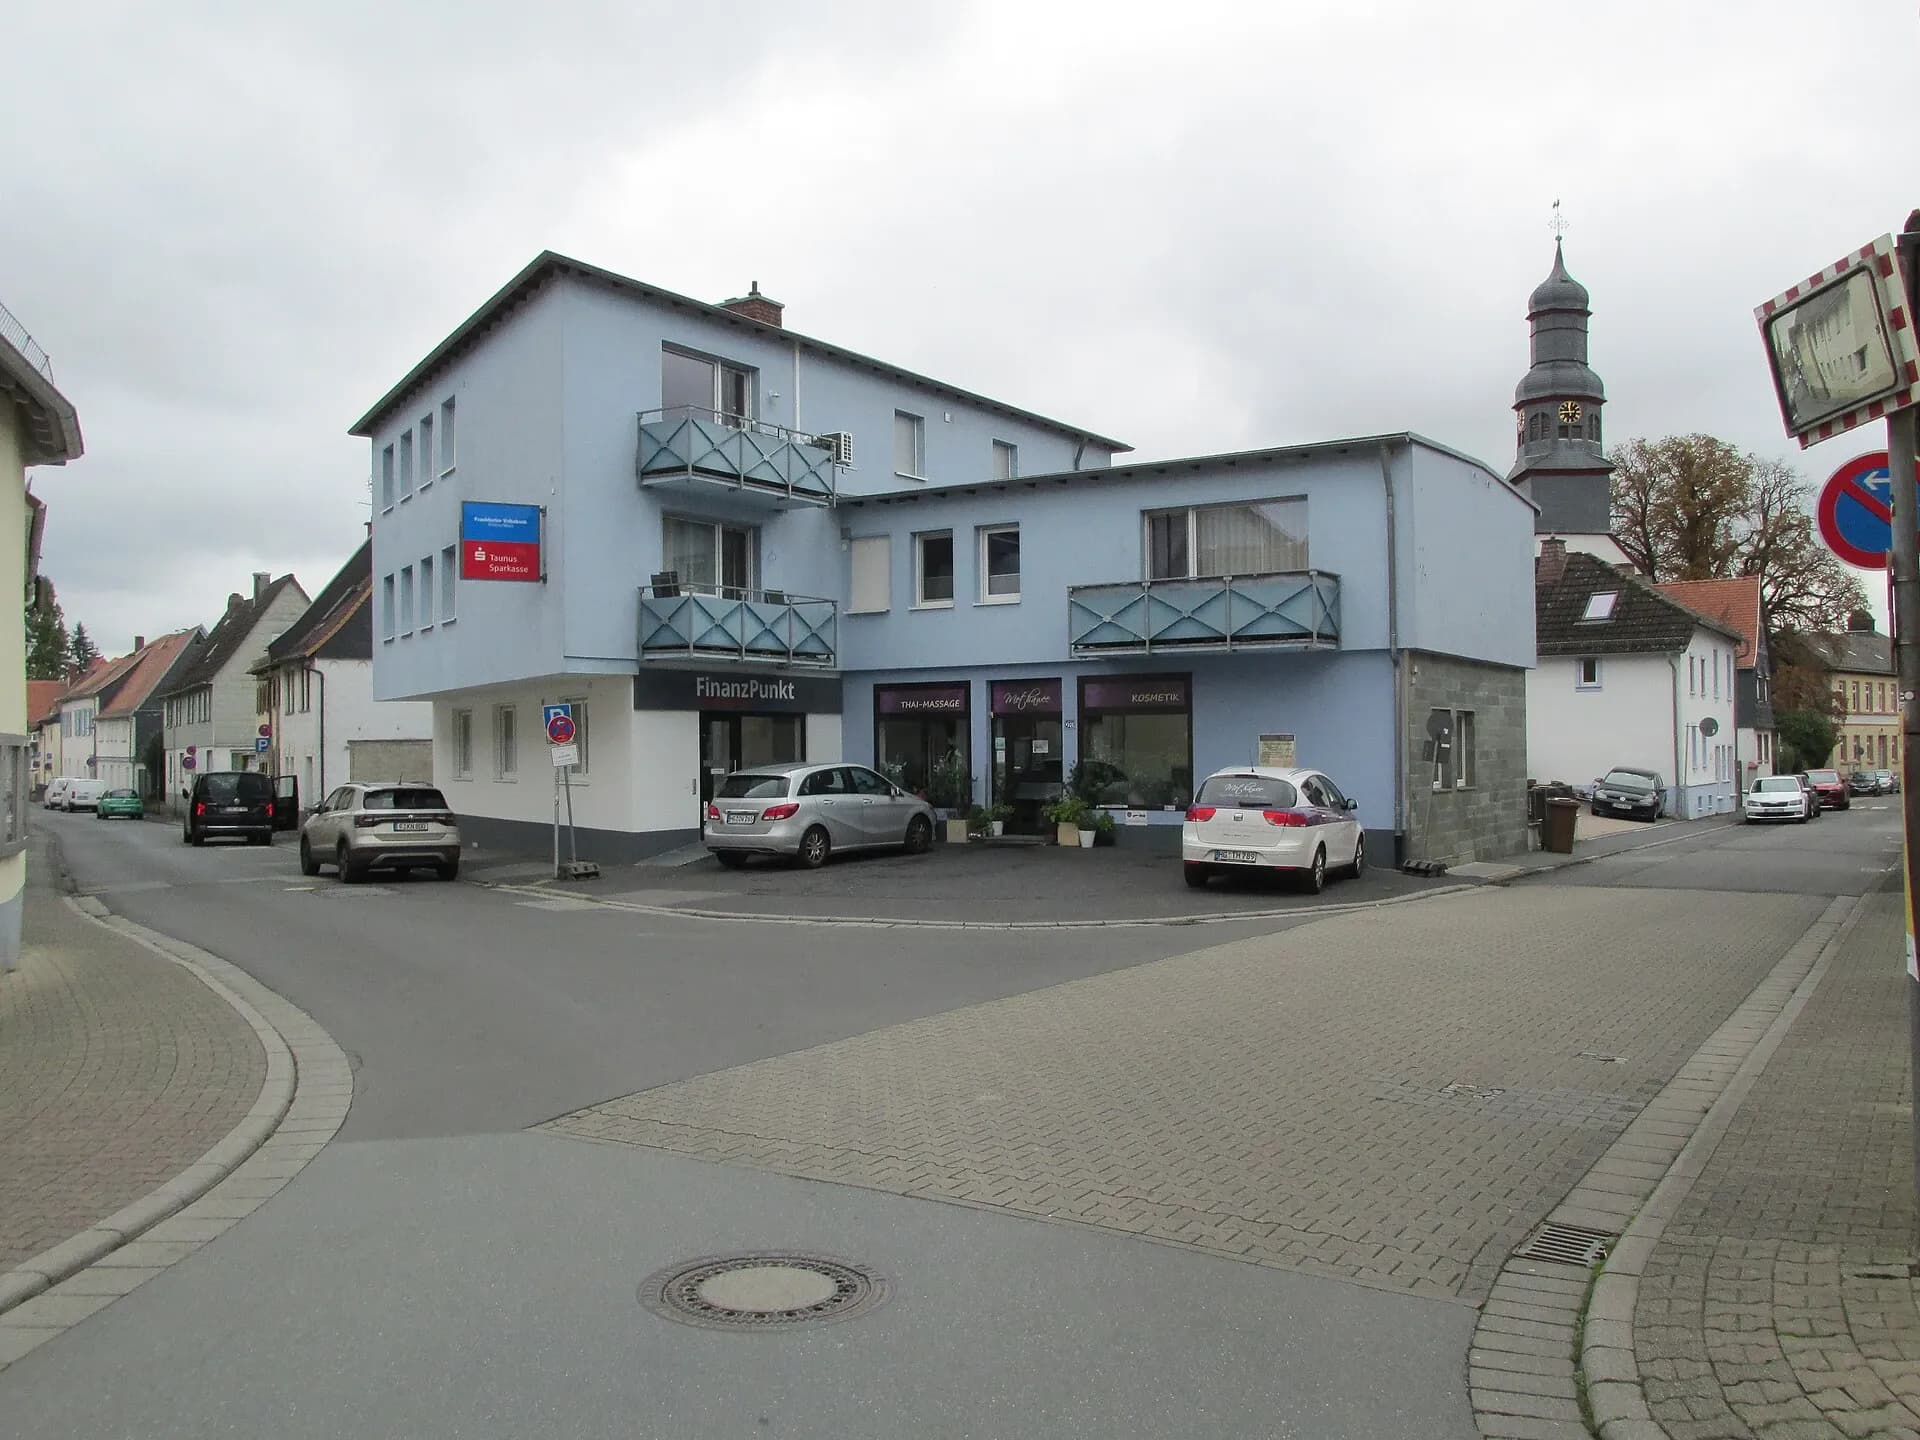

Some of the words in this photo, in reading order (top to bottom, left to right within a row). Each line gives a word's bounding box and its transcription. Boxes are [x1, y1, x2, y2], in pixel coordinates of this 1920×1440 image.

[489, 553, 518, 563] Taunus
[489, 564, 529, 574] Sparkasse
[696, 676, 795, 700] FinanzPunkt
[1131, 693, 1180, 703] KOSMETIK
[901, 699, 960, 710] THAI-MASSAGE
